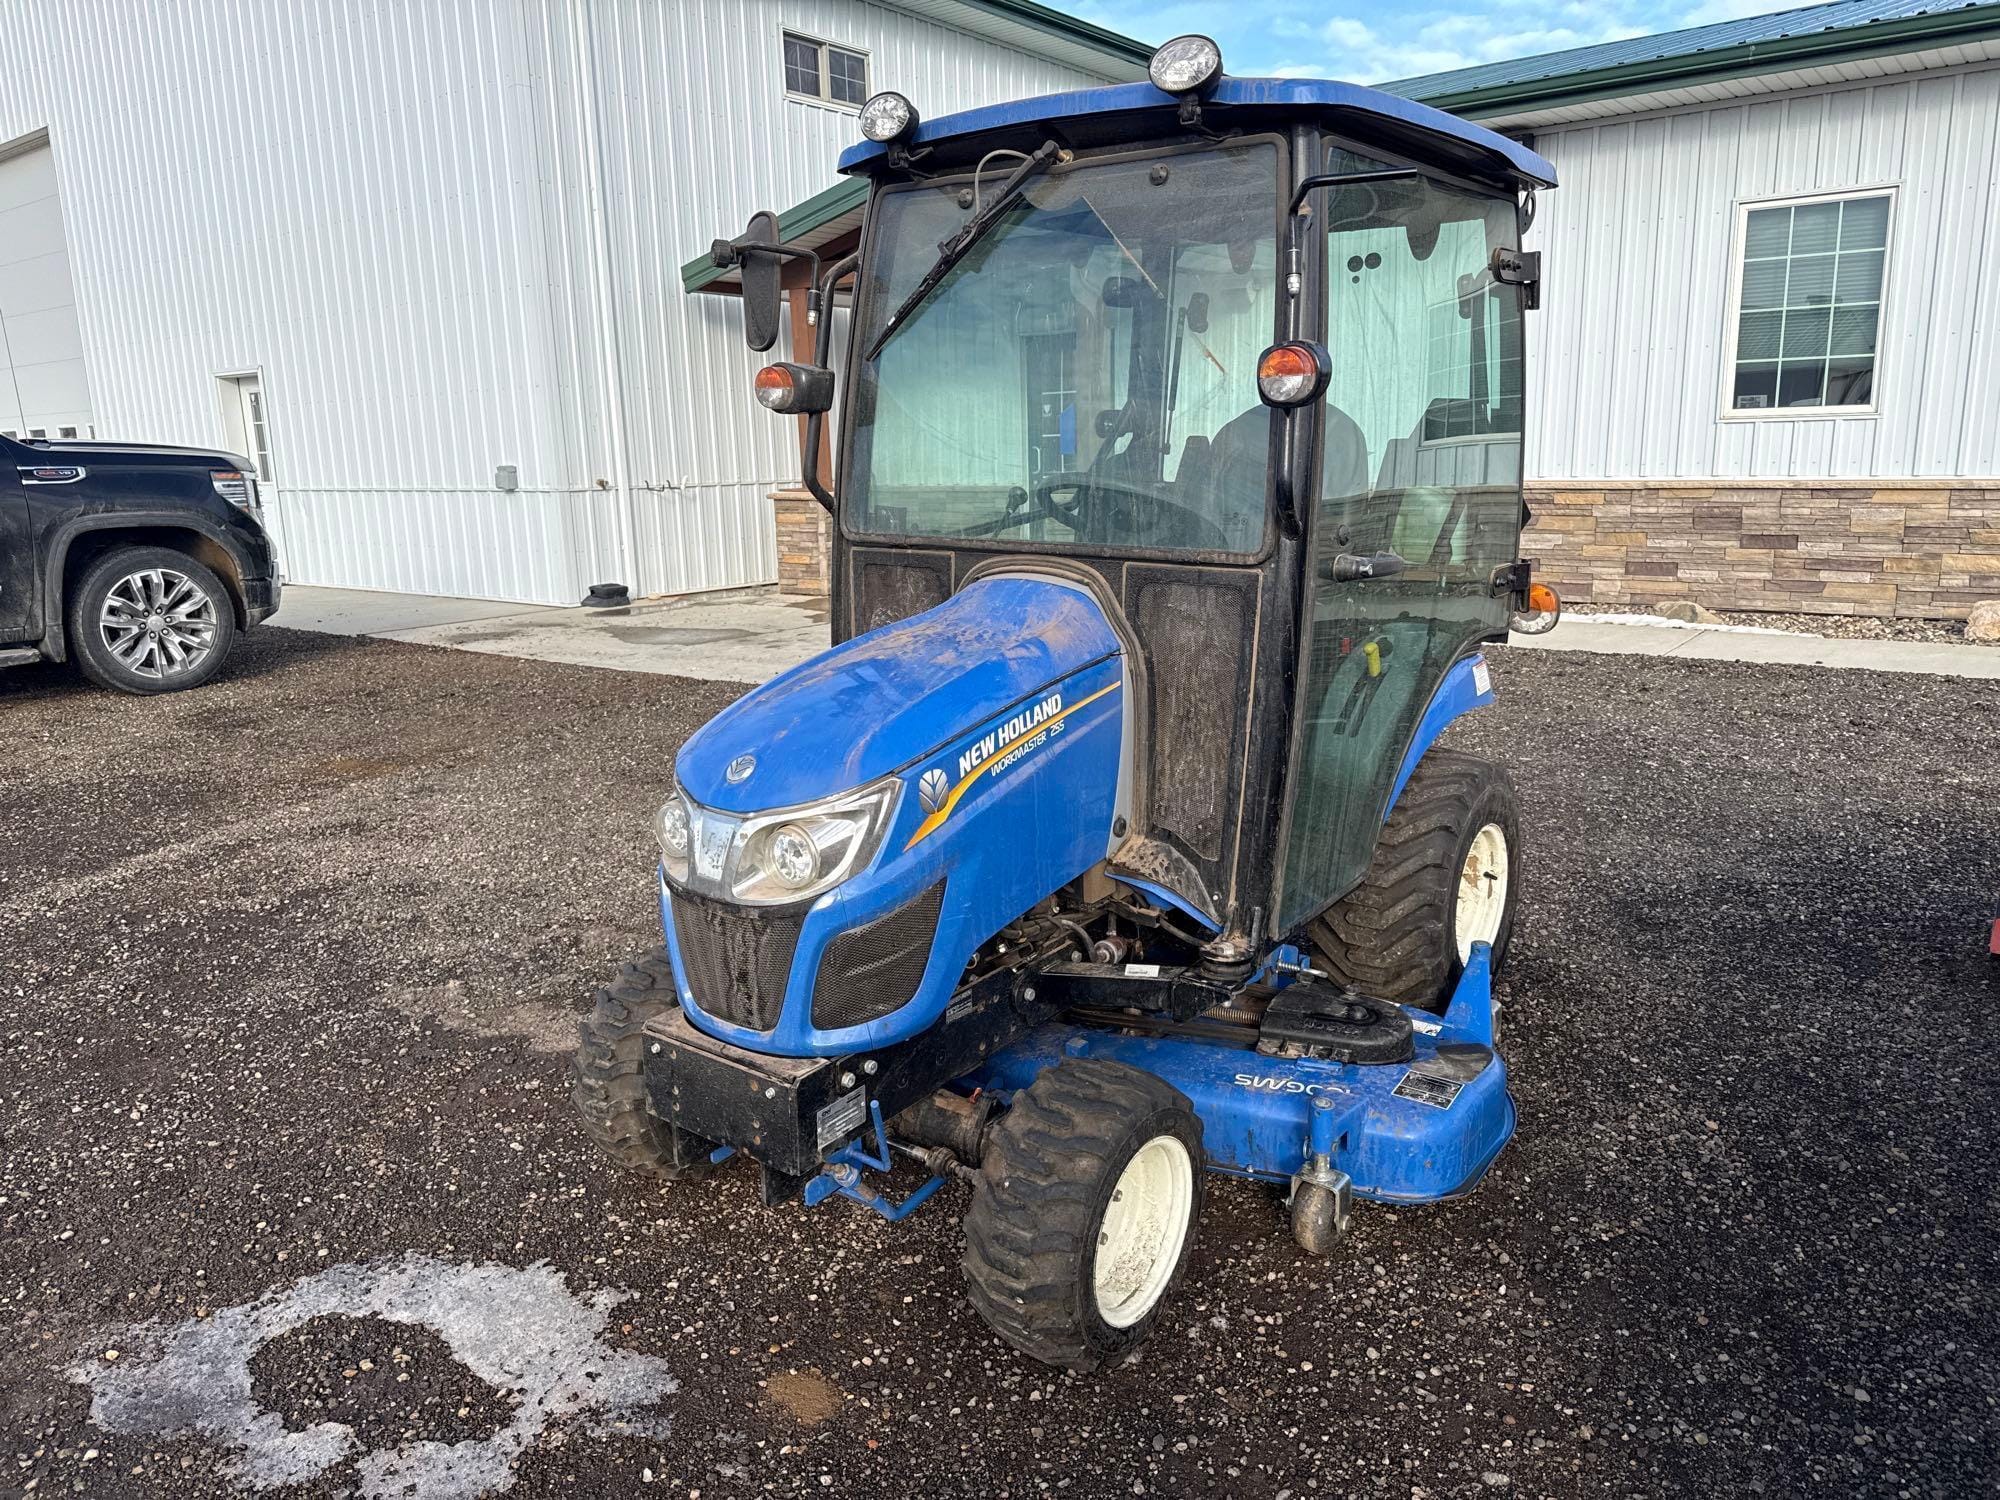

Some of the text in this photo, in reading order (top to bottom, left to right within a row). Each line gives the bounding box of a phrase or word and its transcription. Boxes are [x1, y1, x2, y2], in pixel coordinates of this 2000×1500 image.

[959, 693, 1062, 778] NEW HOLLAND
[991, 732, 1047, 776] WORKMASTER
